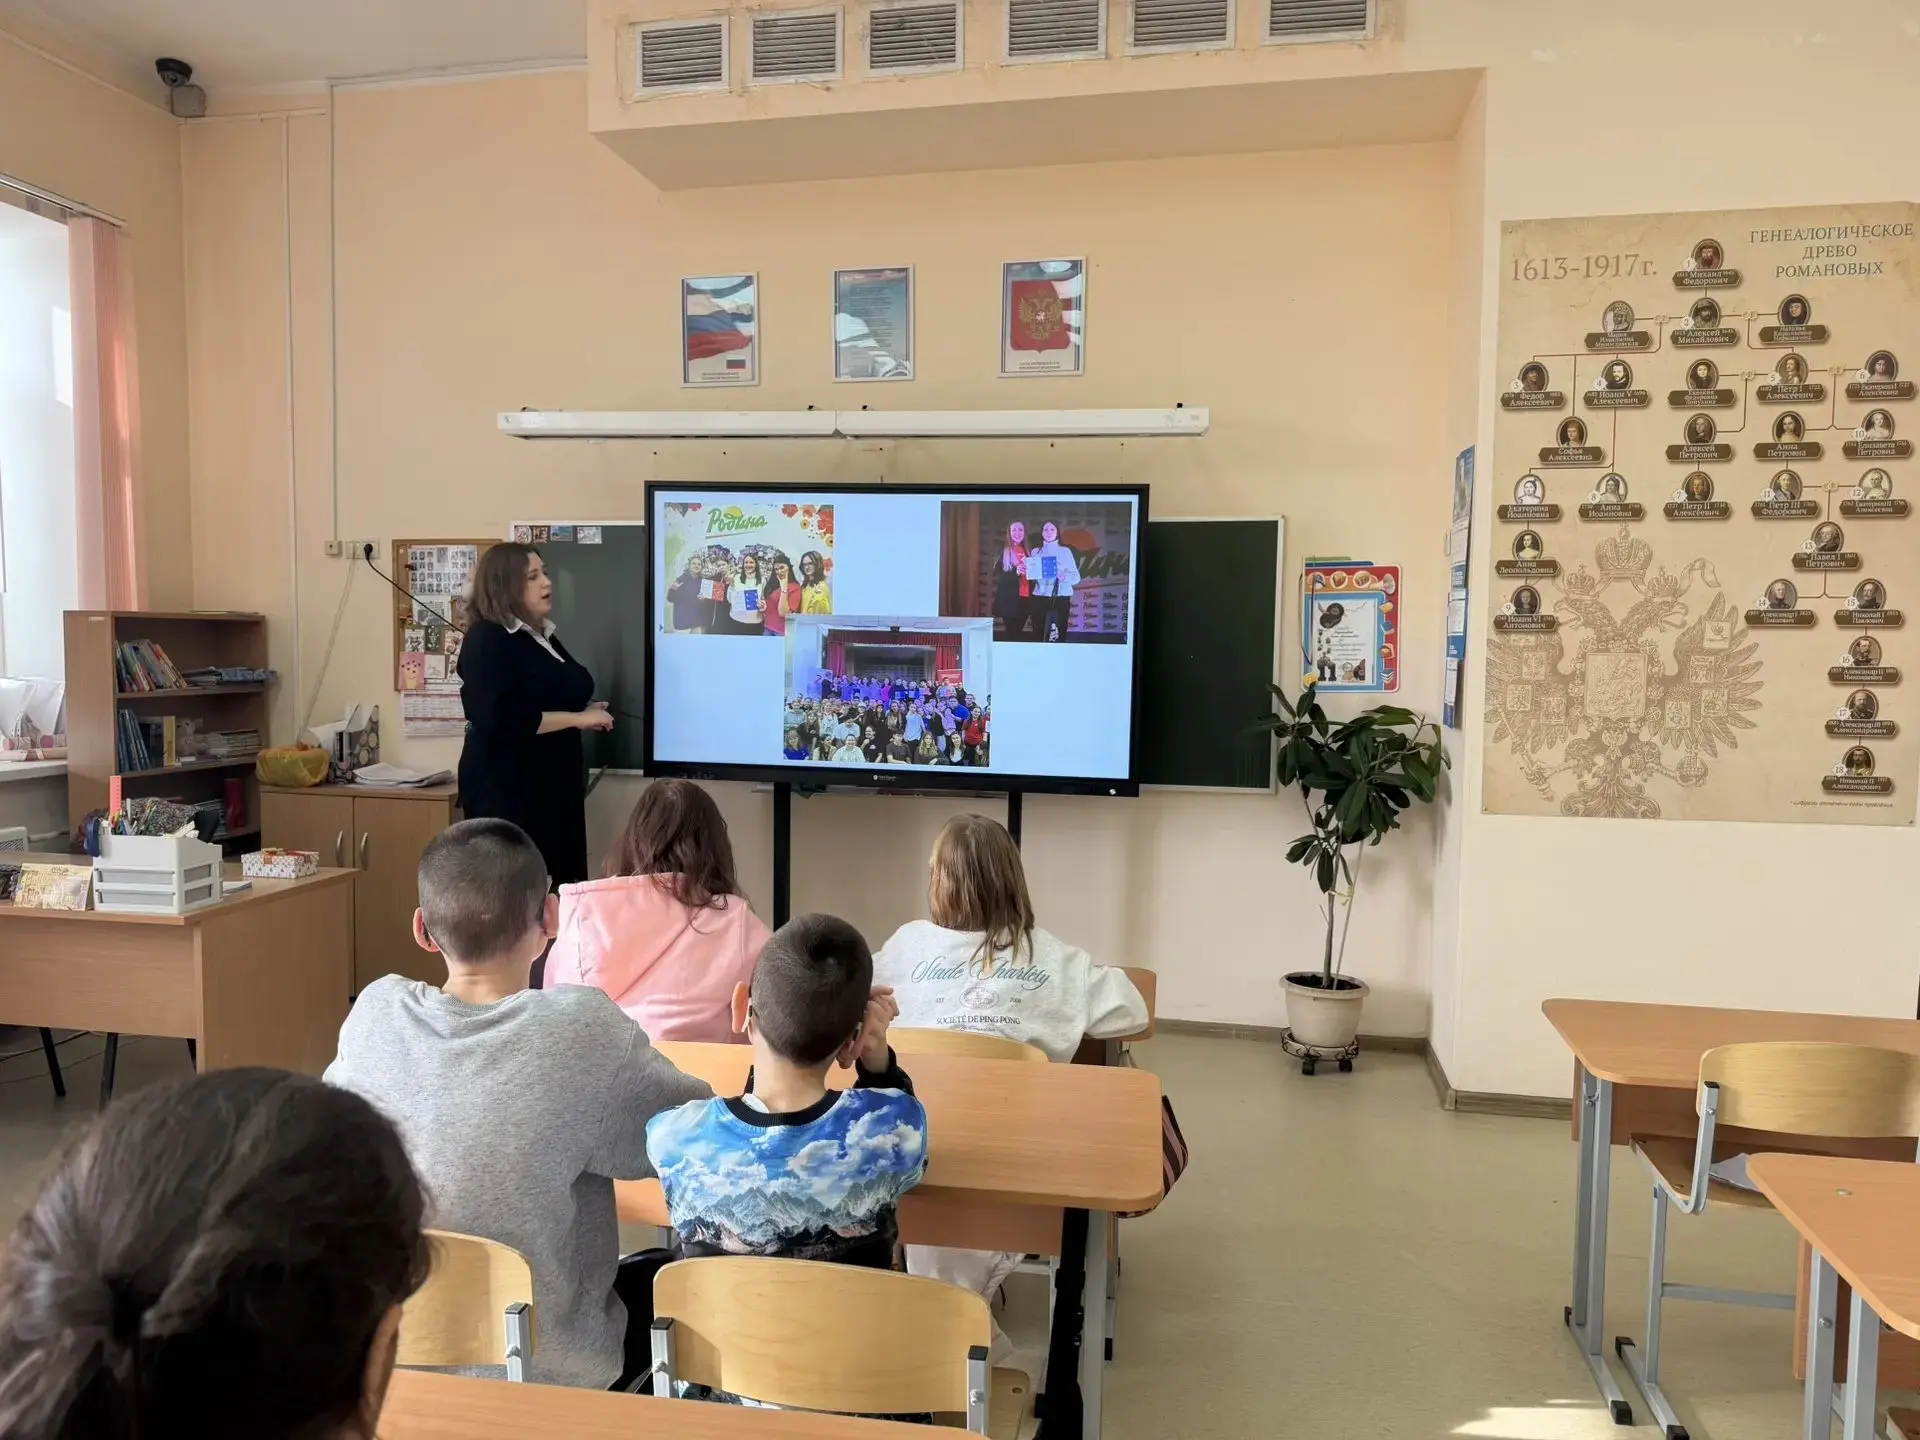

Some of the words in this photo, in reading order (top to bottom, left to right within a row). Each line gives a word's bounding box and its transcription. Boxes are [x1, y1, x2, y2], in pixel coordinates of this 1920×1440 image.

[1749, 223, 1914, 243] ГЕНЕАЛОГИЧЕСКОЕ
[1802, 244, 1857, 260] ДРЕВО
[1689, 270, 1722, 278] Михаил
[1775, 262, 1884, 278] РОМАНОВЫХ
[1682, 277, 1729, 286] Федорович
[1687, 329, 1720, 337] Алексей
[1677, 336, 1729, 344] Михайлович
[1777, 385, 1798, 394] Петр
[1519, 392, 1545, 400] Федор
[1766, 392, 1814, 400] Алексеевич
[1509, 398, 1555, 406] Алексеевич
[1592, 397, 1639, 405] Алексеевич
[1854, 430, 1864, 438] 10
[1682, 444, 1715, 452] Алексей
[1557, 448, 1583, 457] Софья
[1679, 451, 1718, 460] Петрович
[1767, 449, 1807, 457] Петровна
[1852, 488, 1862, 496] 12
[1682, 502, 1704, 511] Петр
[1768, 501, 1790, 510] Петр
[1673, 508, 1719, 516] Алексеевич
[1761, 507, 1807, 516] Федорович
[706, 508, 769, 533] Родина
[1804, 541, 1813, 550] 13
[1810, 553, 1837, 561] Павел
[1805, 560, 1845, 568] Петрович
[1758, 599, 1766, 607] 14
[1847, 598, 1855, 606] 15
[1839, 721, 1875, 729] Александр
[1832, 727, 1887, 735] Александрович
[1835, 766, 1845, 774] 18
[911, 955, 966, 984] Stade
[967, 1014, 979, 1024] DE
[980, 1014, 998, 1024] PING
[1000, 1015, 1021, 1026] PONG
